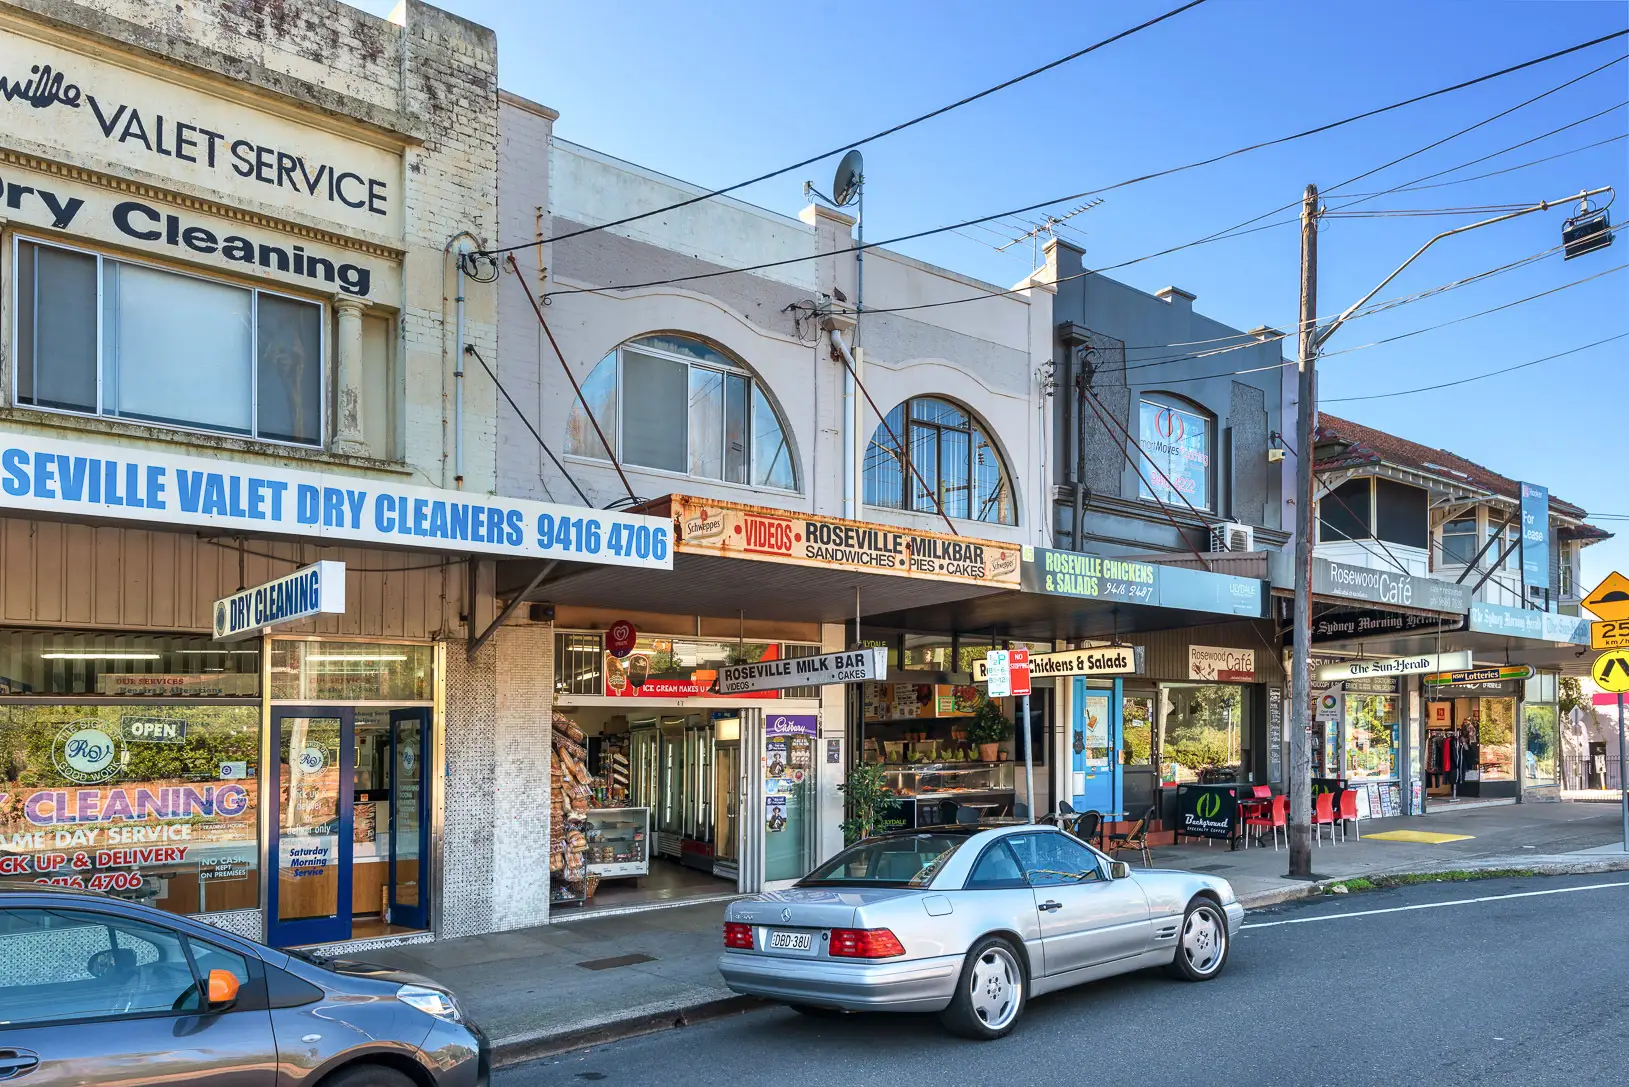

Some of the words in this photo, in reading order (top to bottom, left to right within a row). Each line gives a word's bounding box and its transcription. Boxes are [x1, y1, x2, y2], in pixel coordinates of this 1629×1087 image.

[85, 94, 224, 168] VALET
[231, 139, 388, 216] SERVICE
[0, 180, 85, 230] ry
[112, 201, 372, 297] Cleaning
[2, 448, 166, 510] SEVILLE
[175, 468, 288, 522] VALET
[297, 483, 367, 530] DRY
[374, 493, 524, 547] CLEANERS
[537, 513, 601, 554] 9416
[608, 522, 667, 561] 4706
[687, 520, 721, 535] Schweppes
[1523, 511, 1535, 525] For
[744, 518, 792, 551] VIDEOS
[805, 521, 903, 554] ROSEVILLE
[1523, 526, 1544, 541] Lease
[805, 544, 896, 568] SANDWICHES
[909, 556, 936, 572] PIES
[946, 562, 985, 578] CAKES
[1023, 548, 1034, 561] 45
[991, 558, 1015, 572] Schweppes
[1045, 552, 1101, 577] ROSEVILLE
[1103, 560, 1154, 584] CHICKENS
[1045, 574, 1054, 591] &
[1057, 573, 1099, 596] SALADS
[1104, 582, 1126, 595] 9416
[1128, 585, 1153, 602] 2487
[1331, 564, 1379, 588] Rosewood
[1380, 575, 1412, 605] Café
[229, 592, 253, 632] DRY
[254, 570, 319, 625] CLEANING
[1317, 621, 1355, 635] Sydney
[1358, 616, 1403, 631] Morning
[1602, 623, 1629, 639] 25
[1014, 653, 1024, 661] NO
[1029, 658, 1074, 674] Chickens
[1077, 656, 1085, 671] &
[1088, 653, 1128, 670] Salads
[1192, 648, 1226, 662] Rosewood
[1226, 653, 1252, 672] Café
[1350, 663, 1369, 675] The
[1372, 658, 1430, 673] Sun-Herald
[725, 662, 791, 682] ROSEVILLE
[796, 656, 828, 674] MILK
[835, 653, 865, 669] BAR
[1465, 671, 1499, 681] Lotteries
[642, 684, 656, 692] ICE
[656, 685, 678, 693] CREAM
[679, 685, 699, 693] MAKES
[725, 682, 750, 691] VIDEOS
[838, 669, 866, 681] CAKES
[169, 686, 223, 694] Alterations
[131, 722, 176, 738] OPEN
[774, 716, 806, 734] Cadbury
[59, 761, 87, 780] GOOD
[91, 760, 121, 780] WORK
[24, 784, 248, 827] CLEANING
[1185, 813, 1229, 828] Background
[55, 828, 100, 847] DAY
[108, 824, 192, 843] SERVICE
[35, 852, 66, 872] UP
[72, 850, 92, 870] &
[96, 845, 189, 868] DELIVERY
[290, 847, 329, 857] Saturday
[291, 857, 327, 867] Morning
[88, 872, 144, 891] 4706
[214, 869, 246, 878] PREMISES
[293, 867, 324, 877] Service
